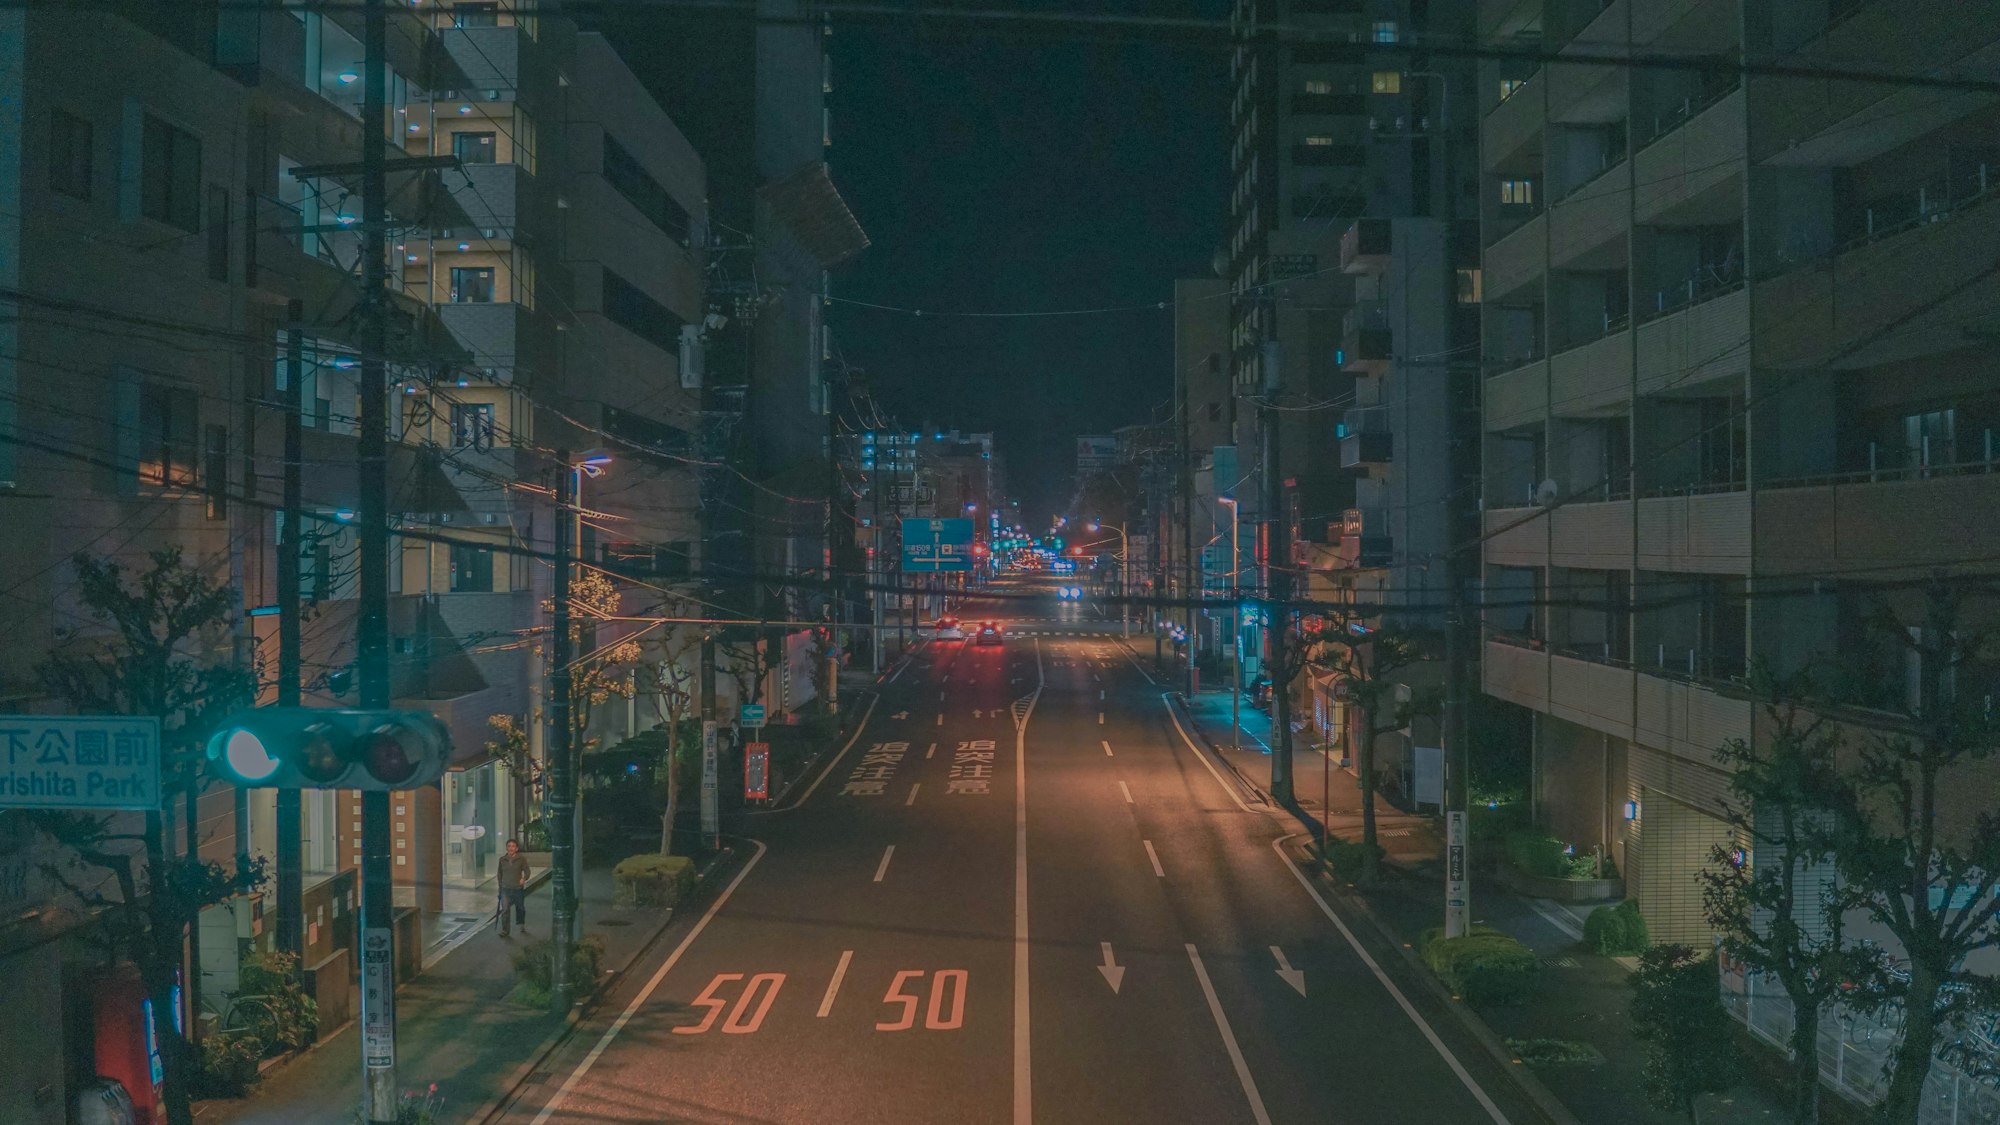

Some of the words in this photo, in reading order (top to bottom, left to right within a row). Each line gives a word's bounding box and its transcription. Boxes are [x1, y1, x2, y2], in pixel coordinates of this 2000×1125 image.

[0, 729, 149, 766] 下公園前
[838, 741, 910, 796] 追突注意
[945, 740, 996, 794] 追突注意
[87, 772, 147, 798] Park
[672, 973, 787, 1034] 50
[876, 969, 968, 1031] 50
